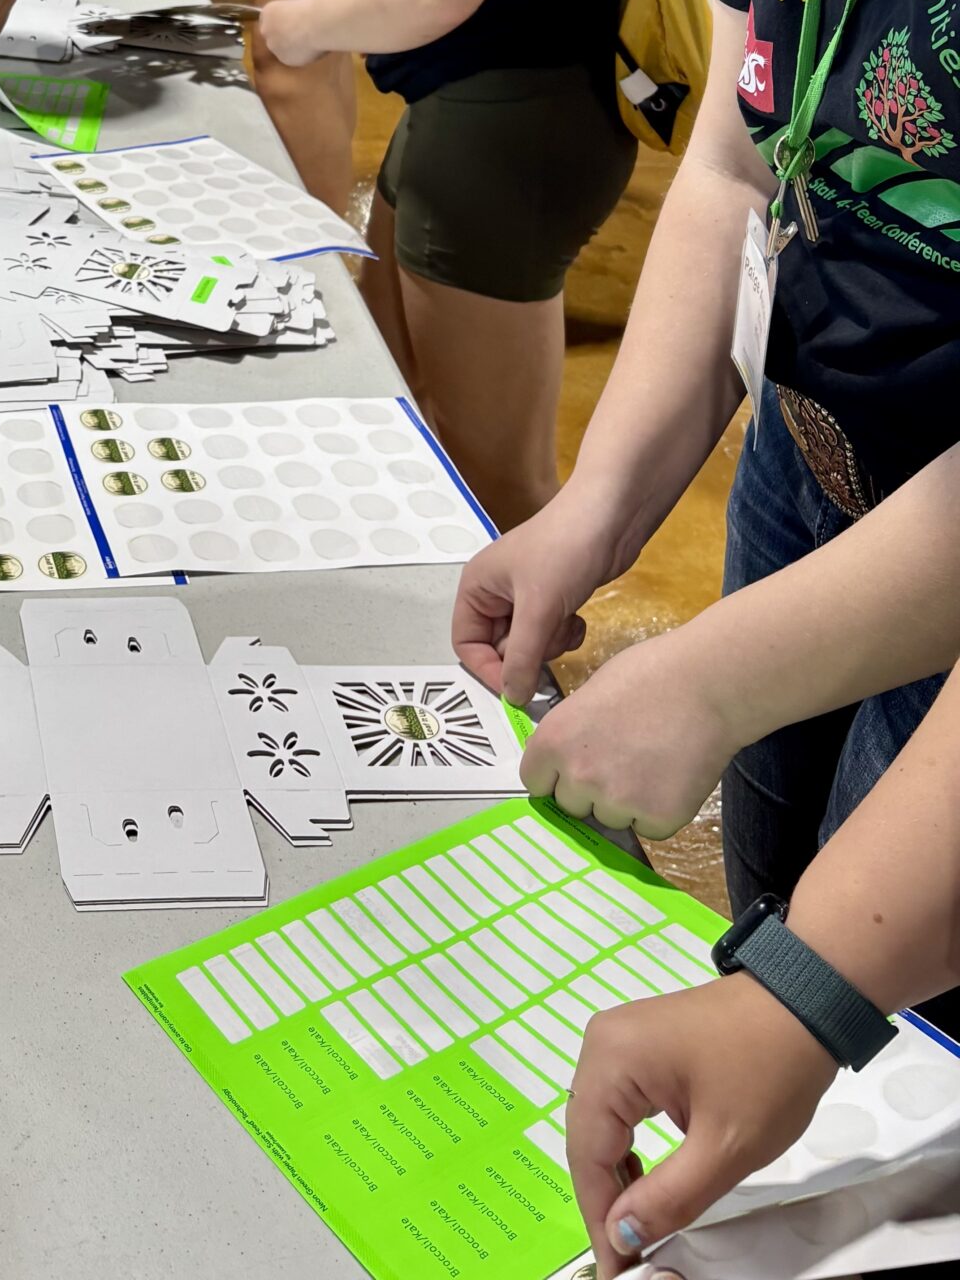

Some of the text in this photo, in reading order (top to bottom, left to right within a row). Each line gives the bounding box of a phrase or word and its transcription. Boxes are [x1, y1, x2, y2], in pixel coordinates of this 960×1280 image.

[851, 201, 883, 230] Teen
[881, 224, 960, 273] Conference
[422, 723, 434, 735] Leaf
[184, 1043, 192, 1052] Go
[281, 1039, 331, 1095] Broccoli/Kale
[308, 1026, 358, 1081] Broccoli/Kale
[222, 1088, 248, 1120] Technology
[254, 1053, 303, 1110] Broccoli/Kale
[433, 1075, 488, 1128] Broccoli/Kale
[459, 1060, 514, 1112] Broccoli/Kale
[261, 1135, 274, 1148] Sure
[380, 1104, 434, 1160] Broccoli/Kale
[406, 1089, 461, 1144] Broccoli/Kale
[272, 1147, 284, 1161] with
[283, 1160, 299, 1178] Paper
[324, 1133, 378, 1193] Broccoli/Kale
[352, 1119, 406, 1176] Broccoli/Kale
[297, 1175, 314, 1195] Green
[312, 1194, 329, 1212] Neon
[486, 1166, 545, 1222] Broccoli/Kale
[513, 1149, 573, 1203] Broccoli/Kale
[430, 1200, 489, 1260] Broccoli/Kale
[458, 1183, 517, 1242] Broccoli/Kale
[401, 1217, 460, 1278] Broccoli/Kale
